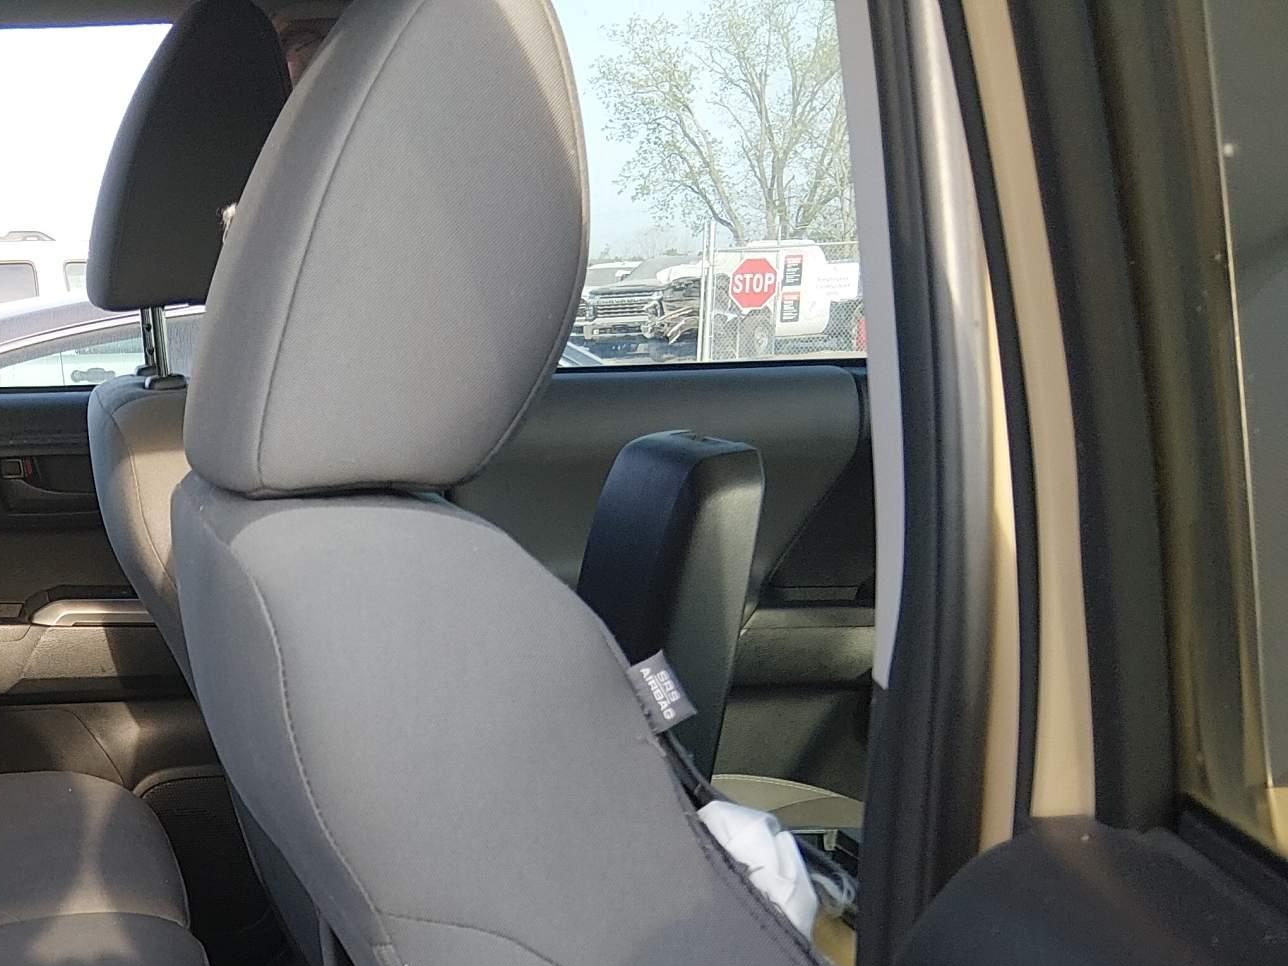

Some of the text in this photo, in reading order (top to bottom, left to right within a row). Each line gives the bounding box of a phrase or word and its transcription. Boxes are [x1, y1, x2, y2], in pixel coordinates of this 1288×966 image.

[732, 273, 775, 294] STOP
[640, 667, 677, 720] AIRBAG
[657, 670, 681, 702] SRS
